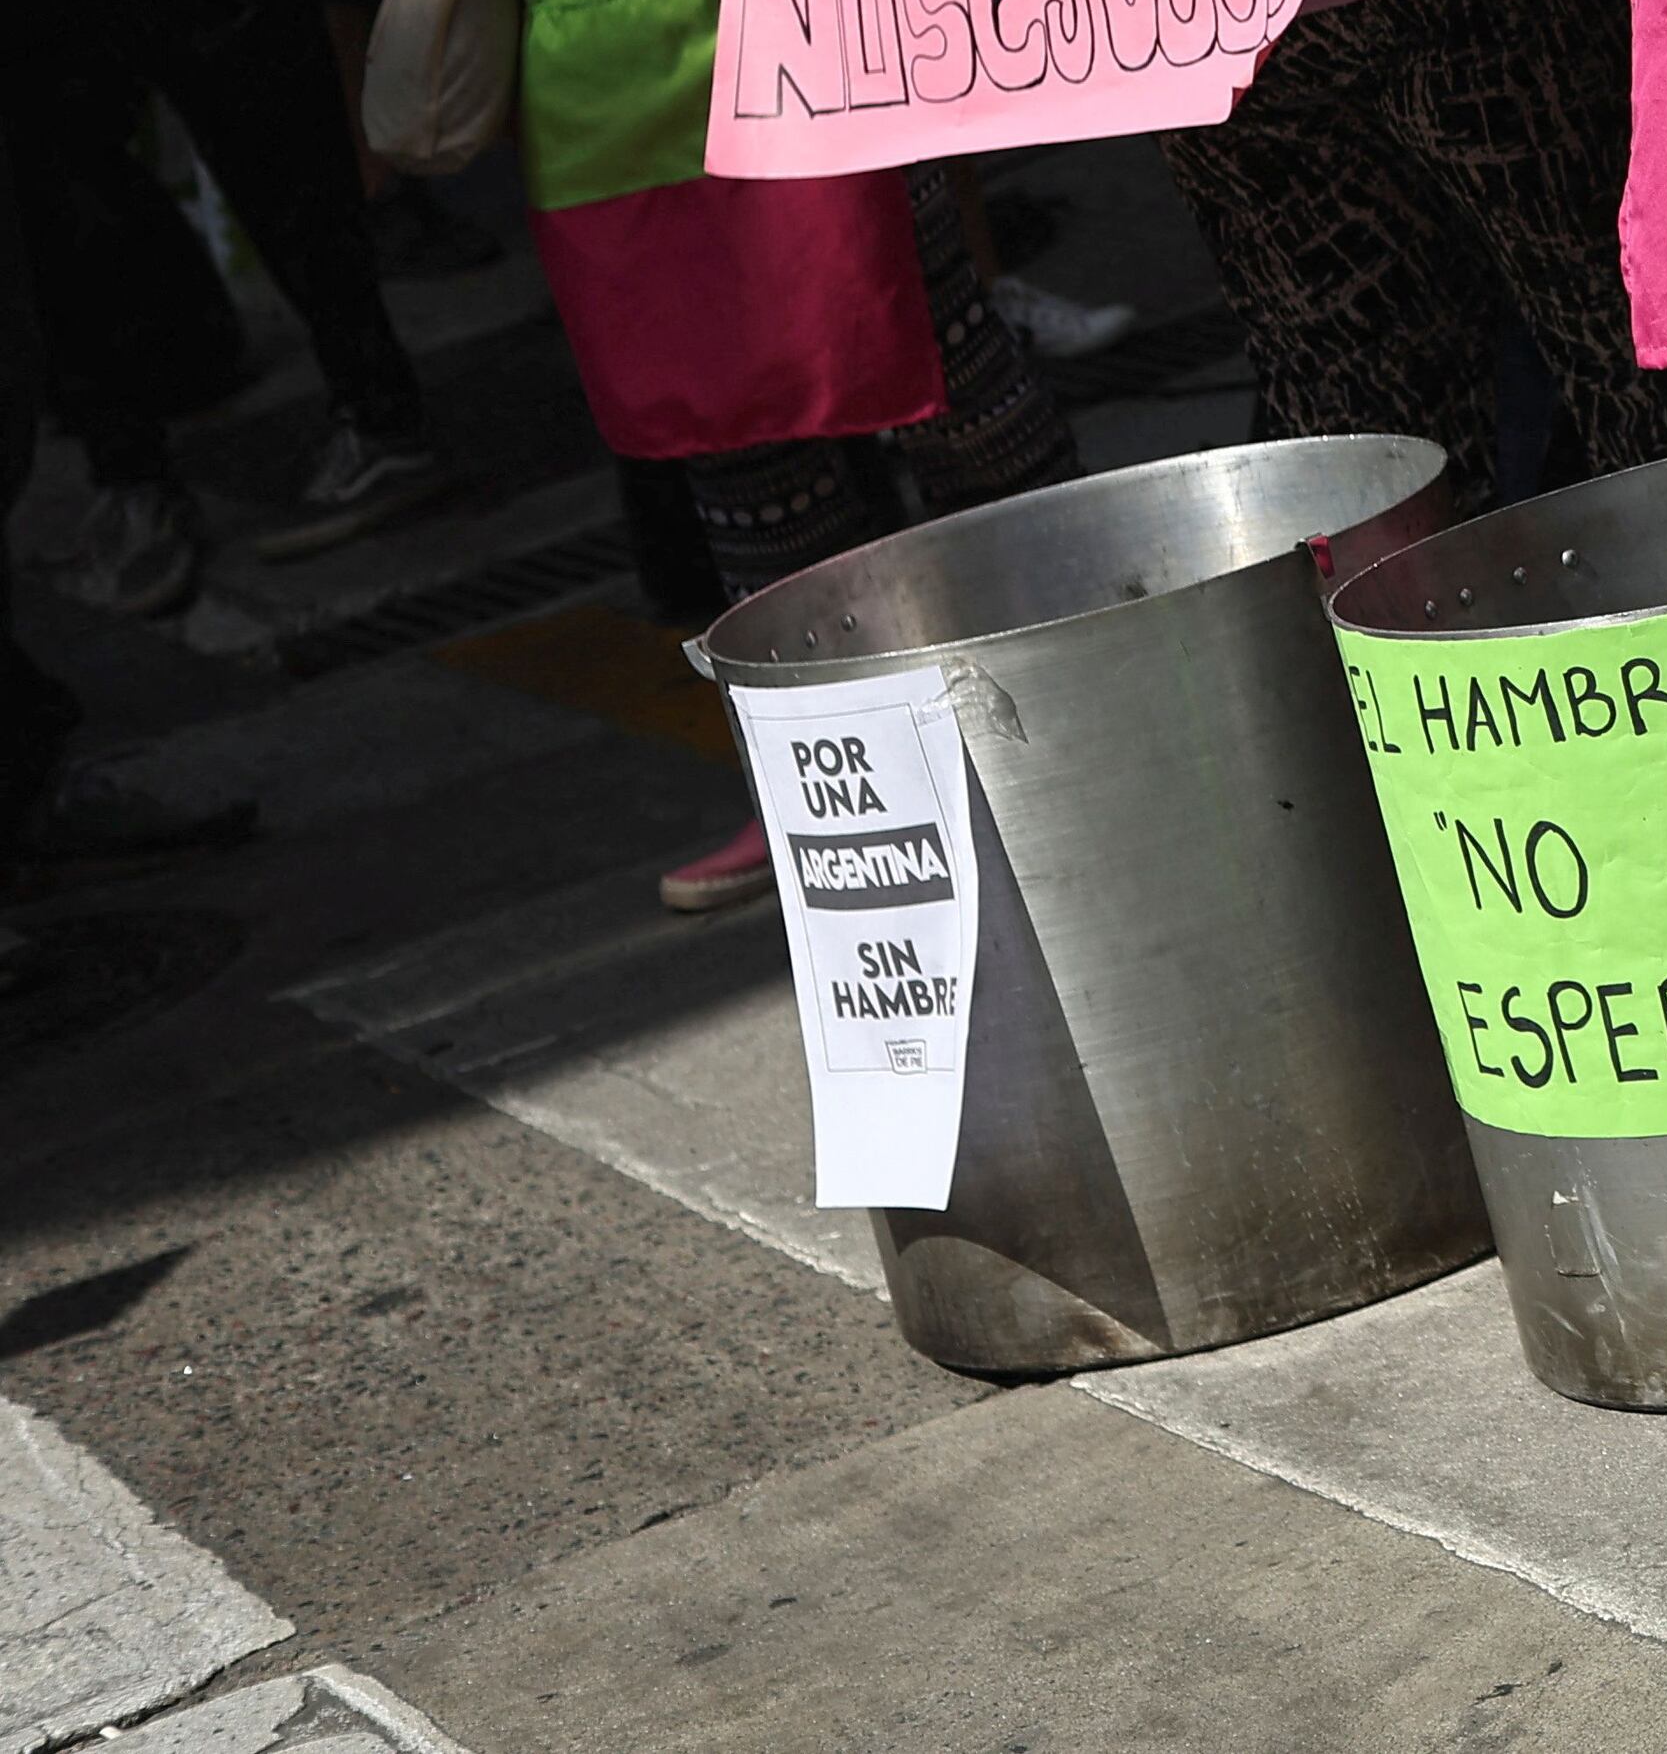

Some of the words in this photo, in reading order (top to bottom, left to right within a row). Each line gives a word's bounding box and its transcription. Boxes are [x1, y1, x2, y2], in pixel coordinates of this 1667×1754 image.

[790, 735, 875, 778] POR
[801, 777, 889, 819] UNA
[801, 837, 950, 892] ARGENTINA
[856, 939, 923, 979] SIN
[831, 977, 958, 1020] HAMBRE
